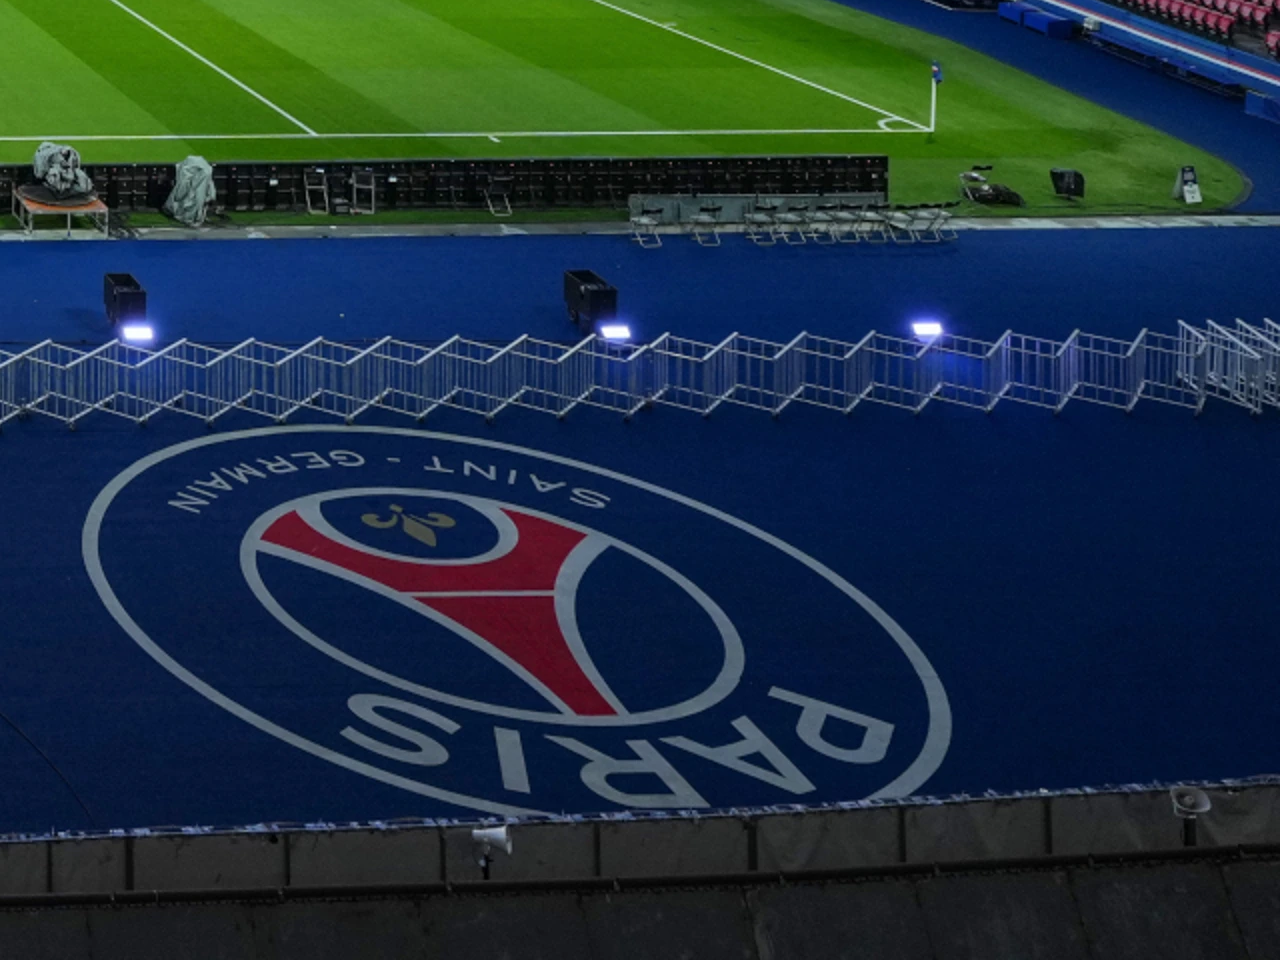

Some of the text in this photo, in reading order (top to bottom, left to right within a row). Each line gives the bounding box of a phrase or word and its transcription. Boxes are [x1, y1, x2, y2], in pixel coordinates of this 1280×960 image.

[167, 448, 366, 516] GERMAIN
[424, 454, 612, 511] SAINT
[339, 685, 896, 810] PARIS
